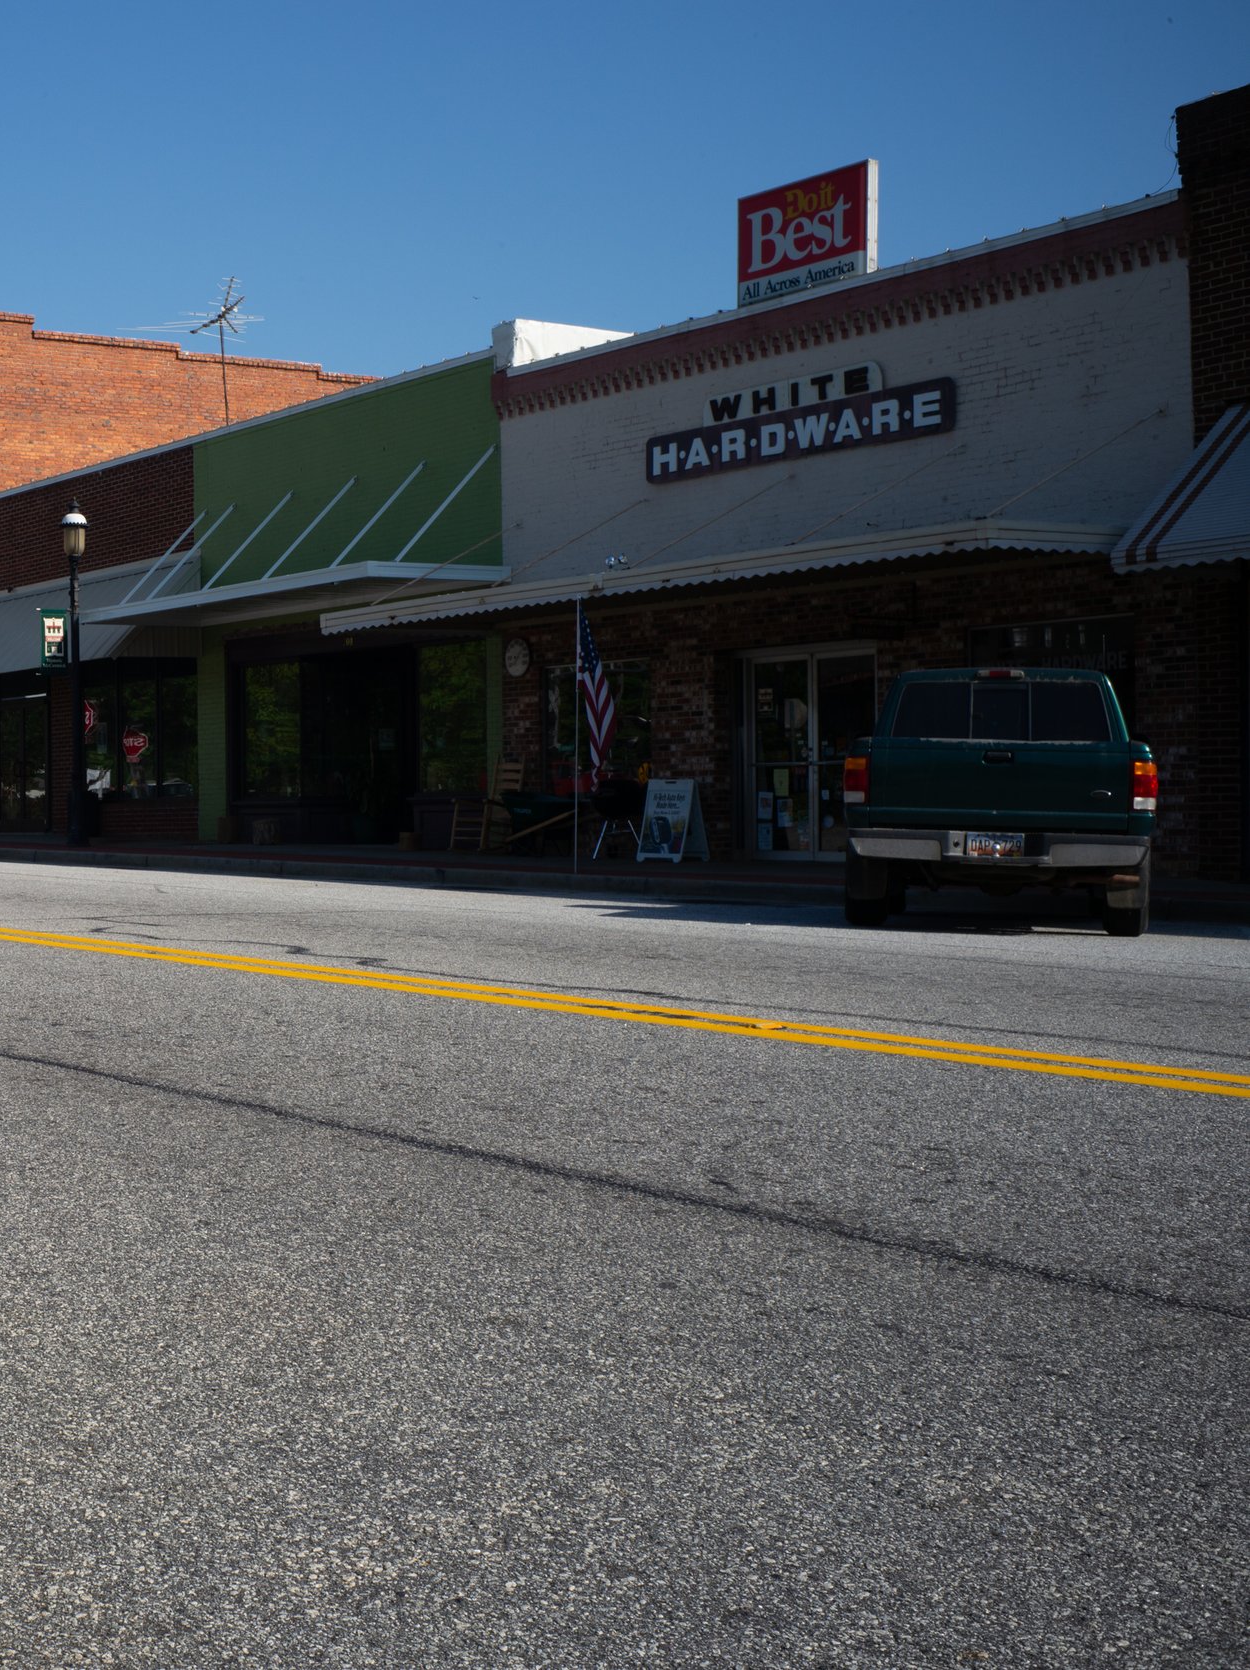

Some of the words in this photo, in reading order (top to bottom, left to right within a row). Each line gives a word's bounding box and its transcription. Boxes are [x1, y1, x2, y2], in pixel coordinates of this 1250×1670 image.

[784, 189, 818, 219] Do
[819, 181, 836, 209] it
[746, 192, 852, 273] Best
[742, 281, 760, 301] All
[764, 276, 801, 295] Across
[804, 260, 855, 284] America
[709, 366, 870, 422] WHITE
